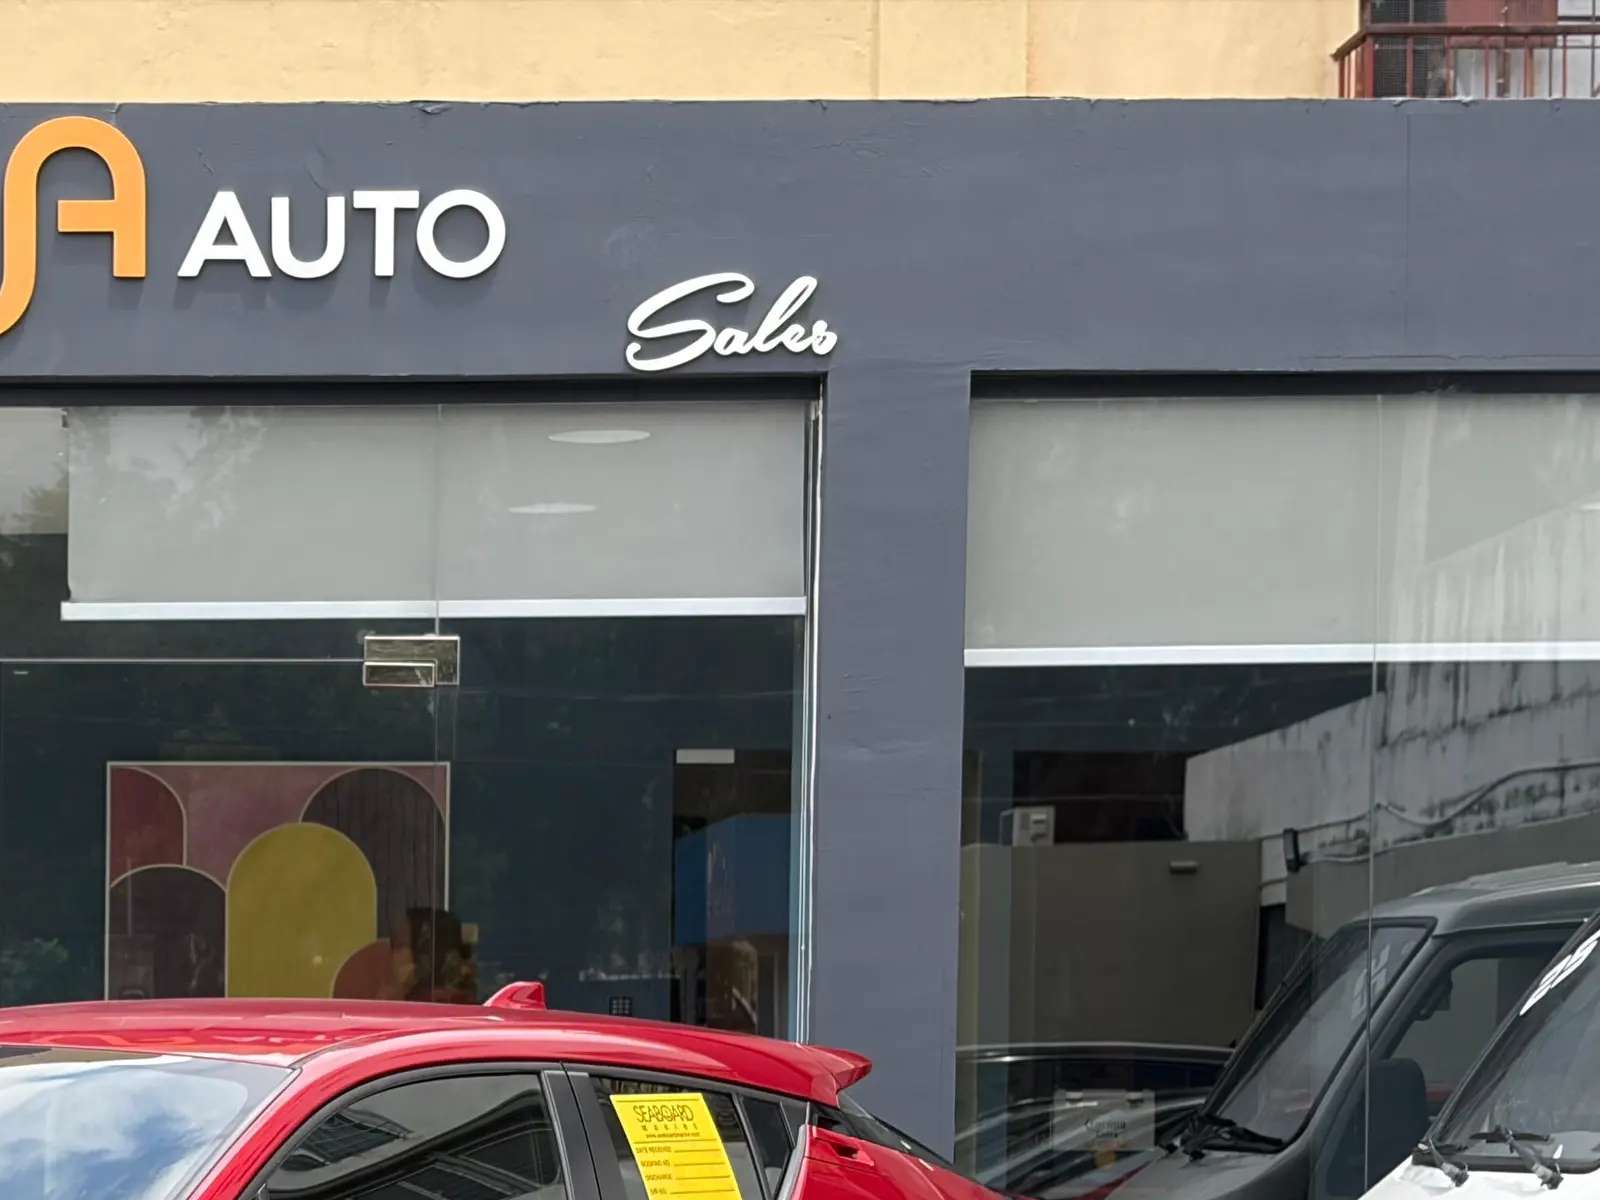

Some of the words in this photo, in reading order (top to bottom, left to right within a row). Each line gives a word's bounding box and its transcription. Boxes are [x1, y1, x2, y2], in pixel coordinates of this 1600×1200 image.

[177, 189, 506, 279] AUTO
[625, 272, 839, 372] Sales
[632, 1104, 694, 1123] SEABOARD
